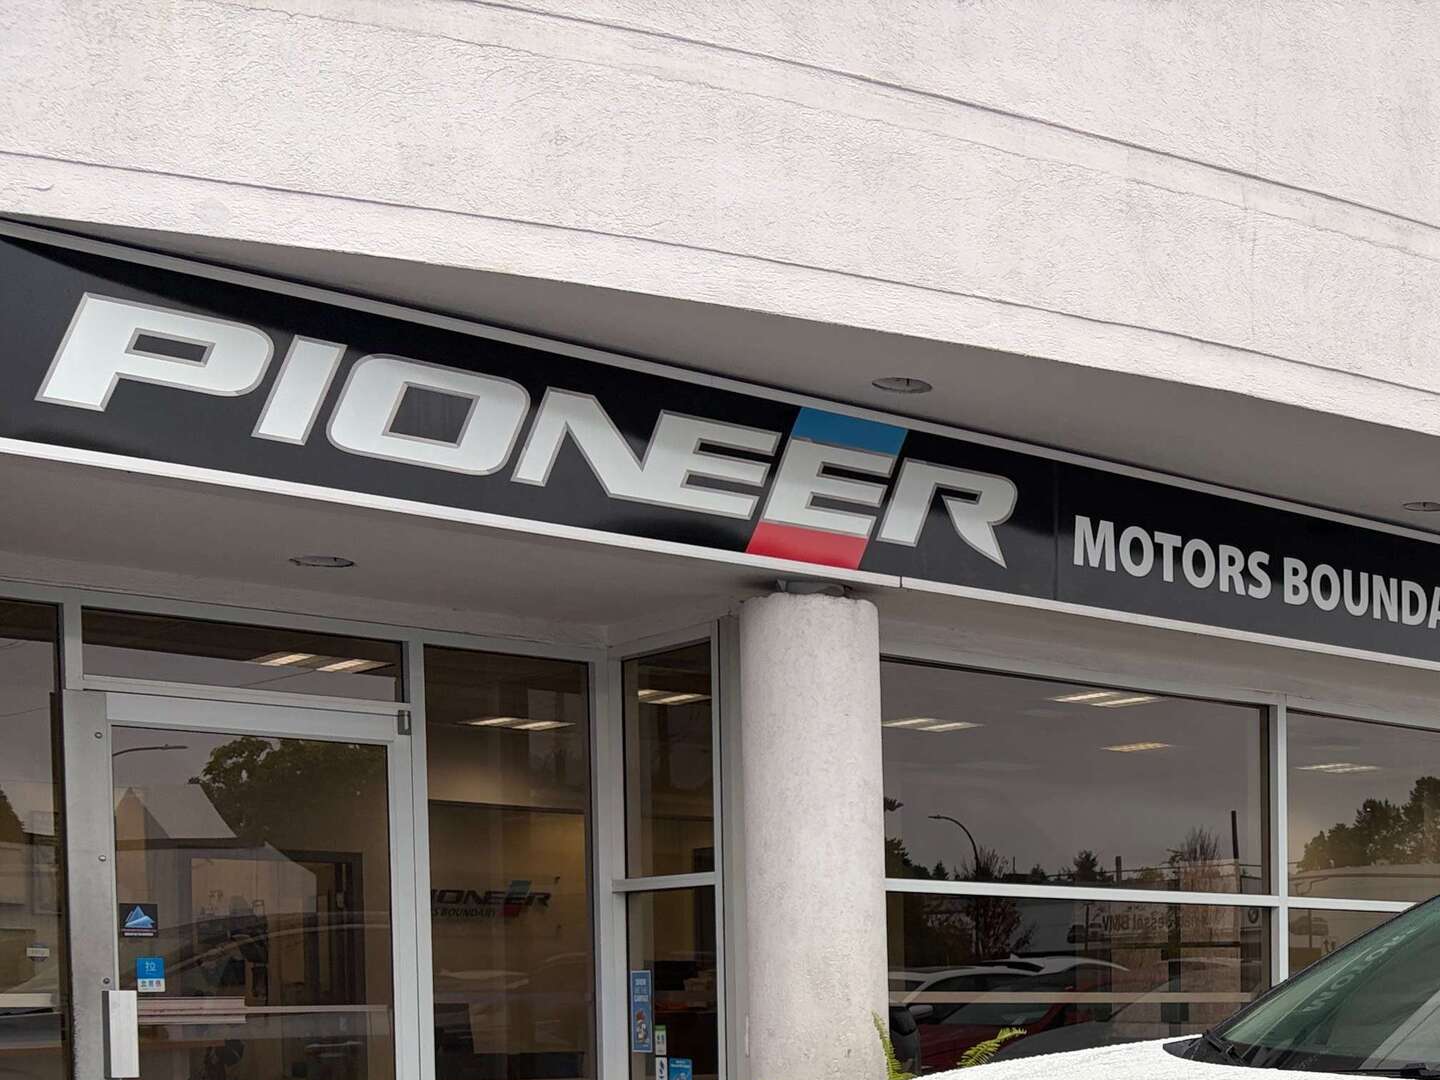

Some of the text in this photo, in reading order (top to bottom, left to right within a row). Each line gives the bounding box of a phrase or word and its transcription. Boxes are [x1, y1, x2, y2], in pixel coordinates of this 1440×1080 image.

[35, 291, 1018, 568] PIONEER
[1073, 514, 1273, 600] MOTORS
[431, 888, 552, 907] IONEER
